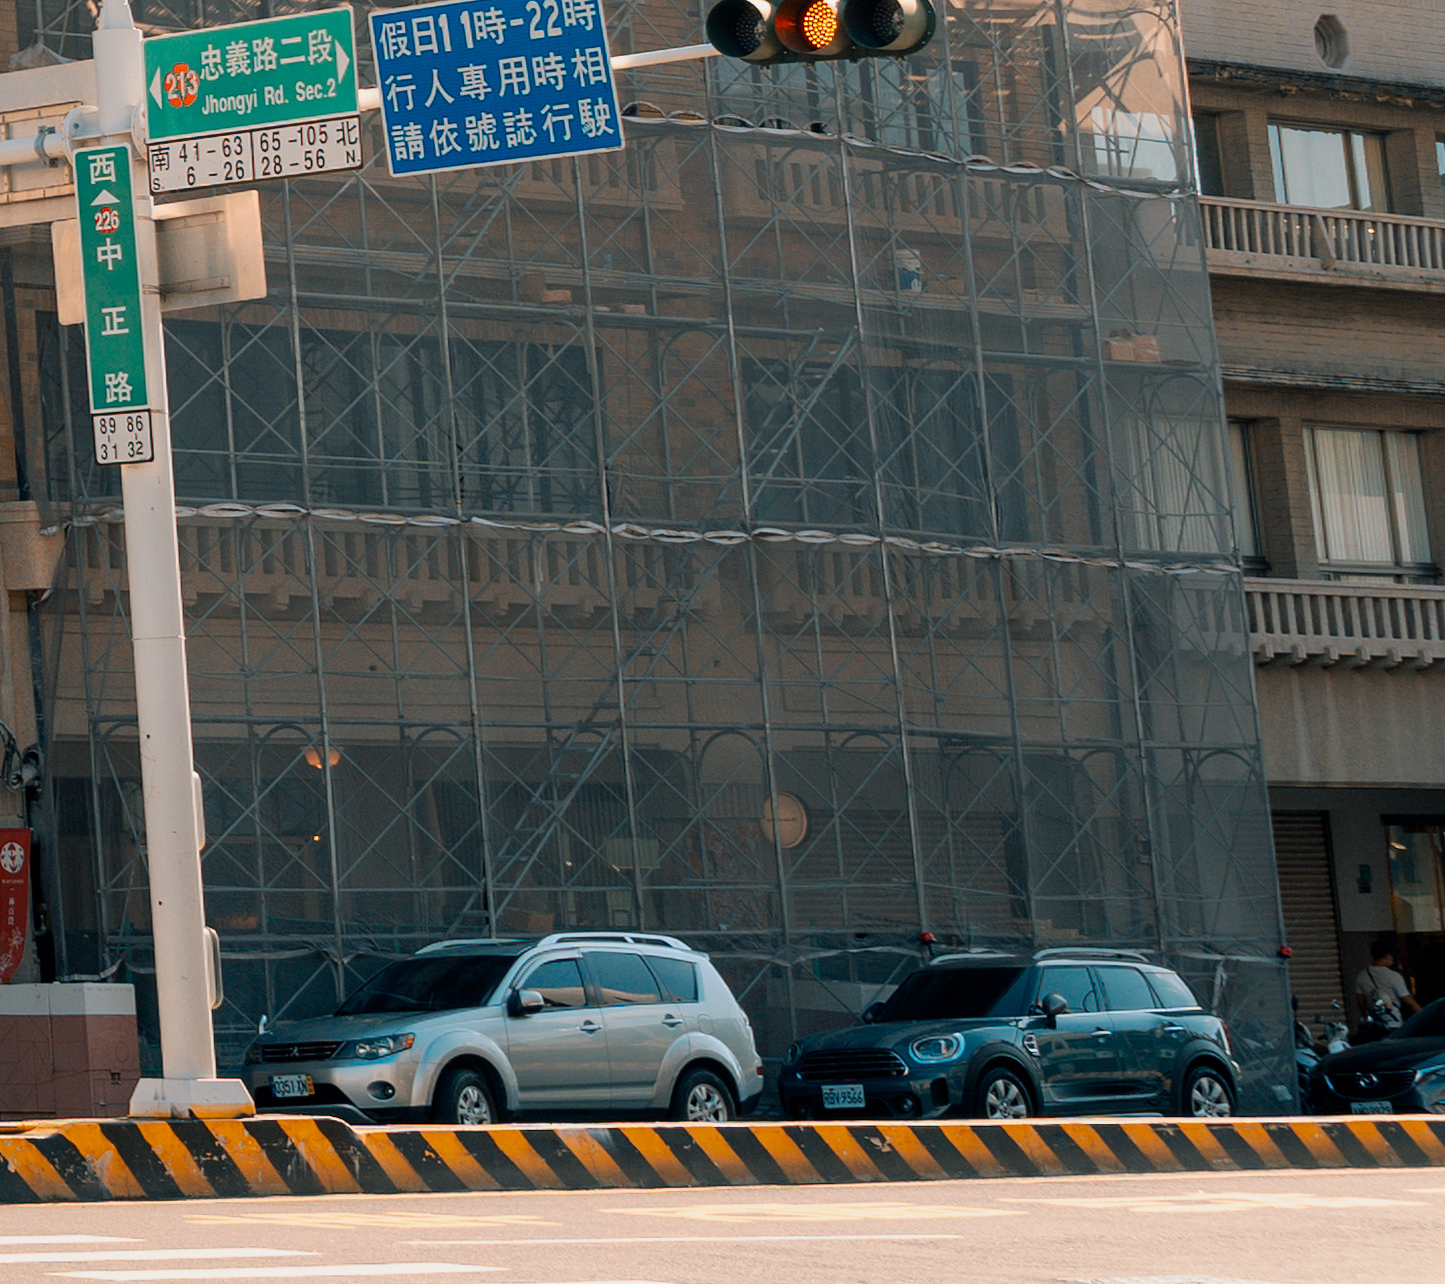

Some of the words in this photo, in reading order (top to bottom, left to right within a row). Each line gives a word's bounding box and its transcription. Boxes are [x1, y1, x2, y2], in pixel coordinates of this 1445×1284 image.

[200, 29, 333, 82] 忠義路二段
[165, 69, 199, 101] 213
[385, 47, 608, 112] 行人專用時相
[201, 89, 258, 115] Jhongyi
[264, 85, 290, 106] Rd.
[295, 78, 337, 102] Sec.2
[335, 121, 359, 147] 北
[391, 97, 615, 162] 請依號誌行駛
[87, 152, 117, 184] 西
[150, 145, 170, 173] 南
[94, 210, 120, 232] 226
[96, 237, 133, 403] 中正路
[99, 417, 116, 434] 89
[126, 415, 144, 432] 86
[100, 443, 118, 460] 31
[127, 441, 144, 458] 32
